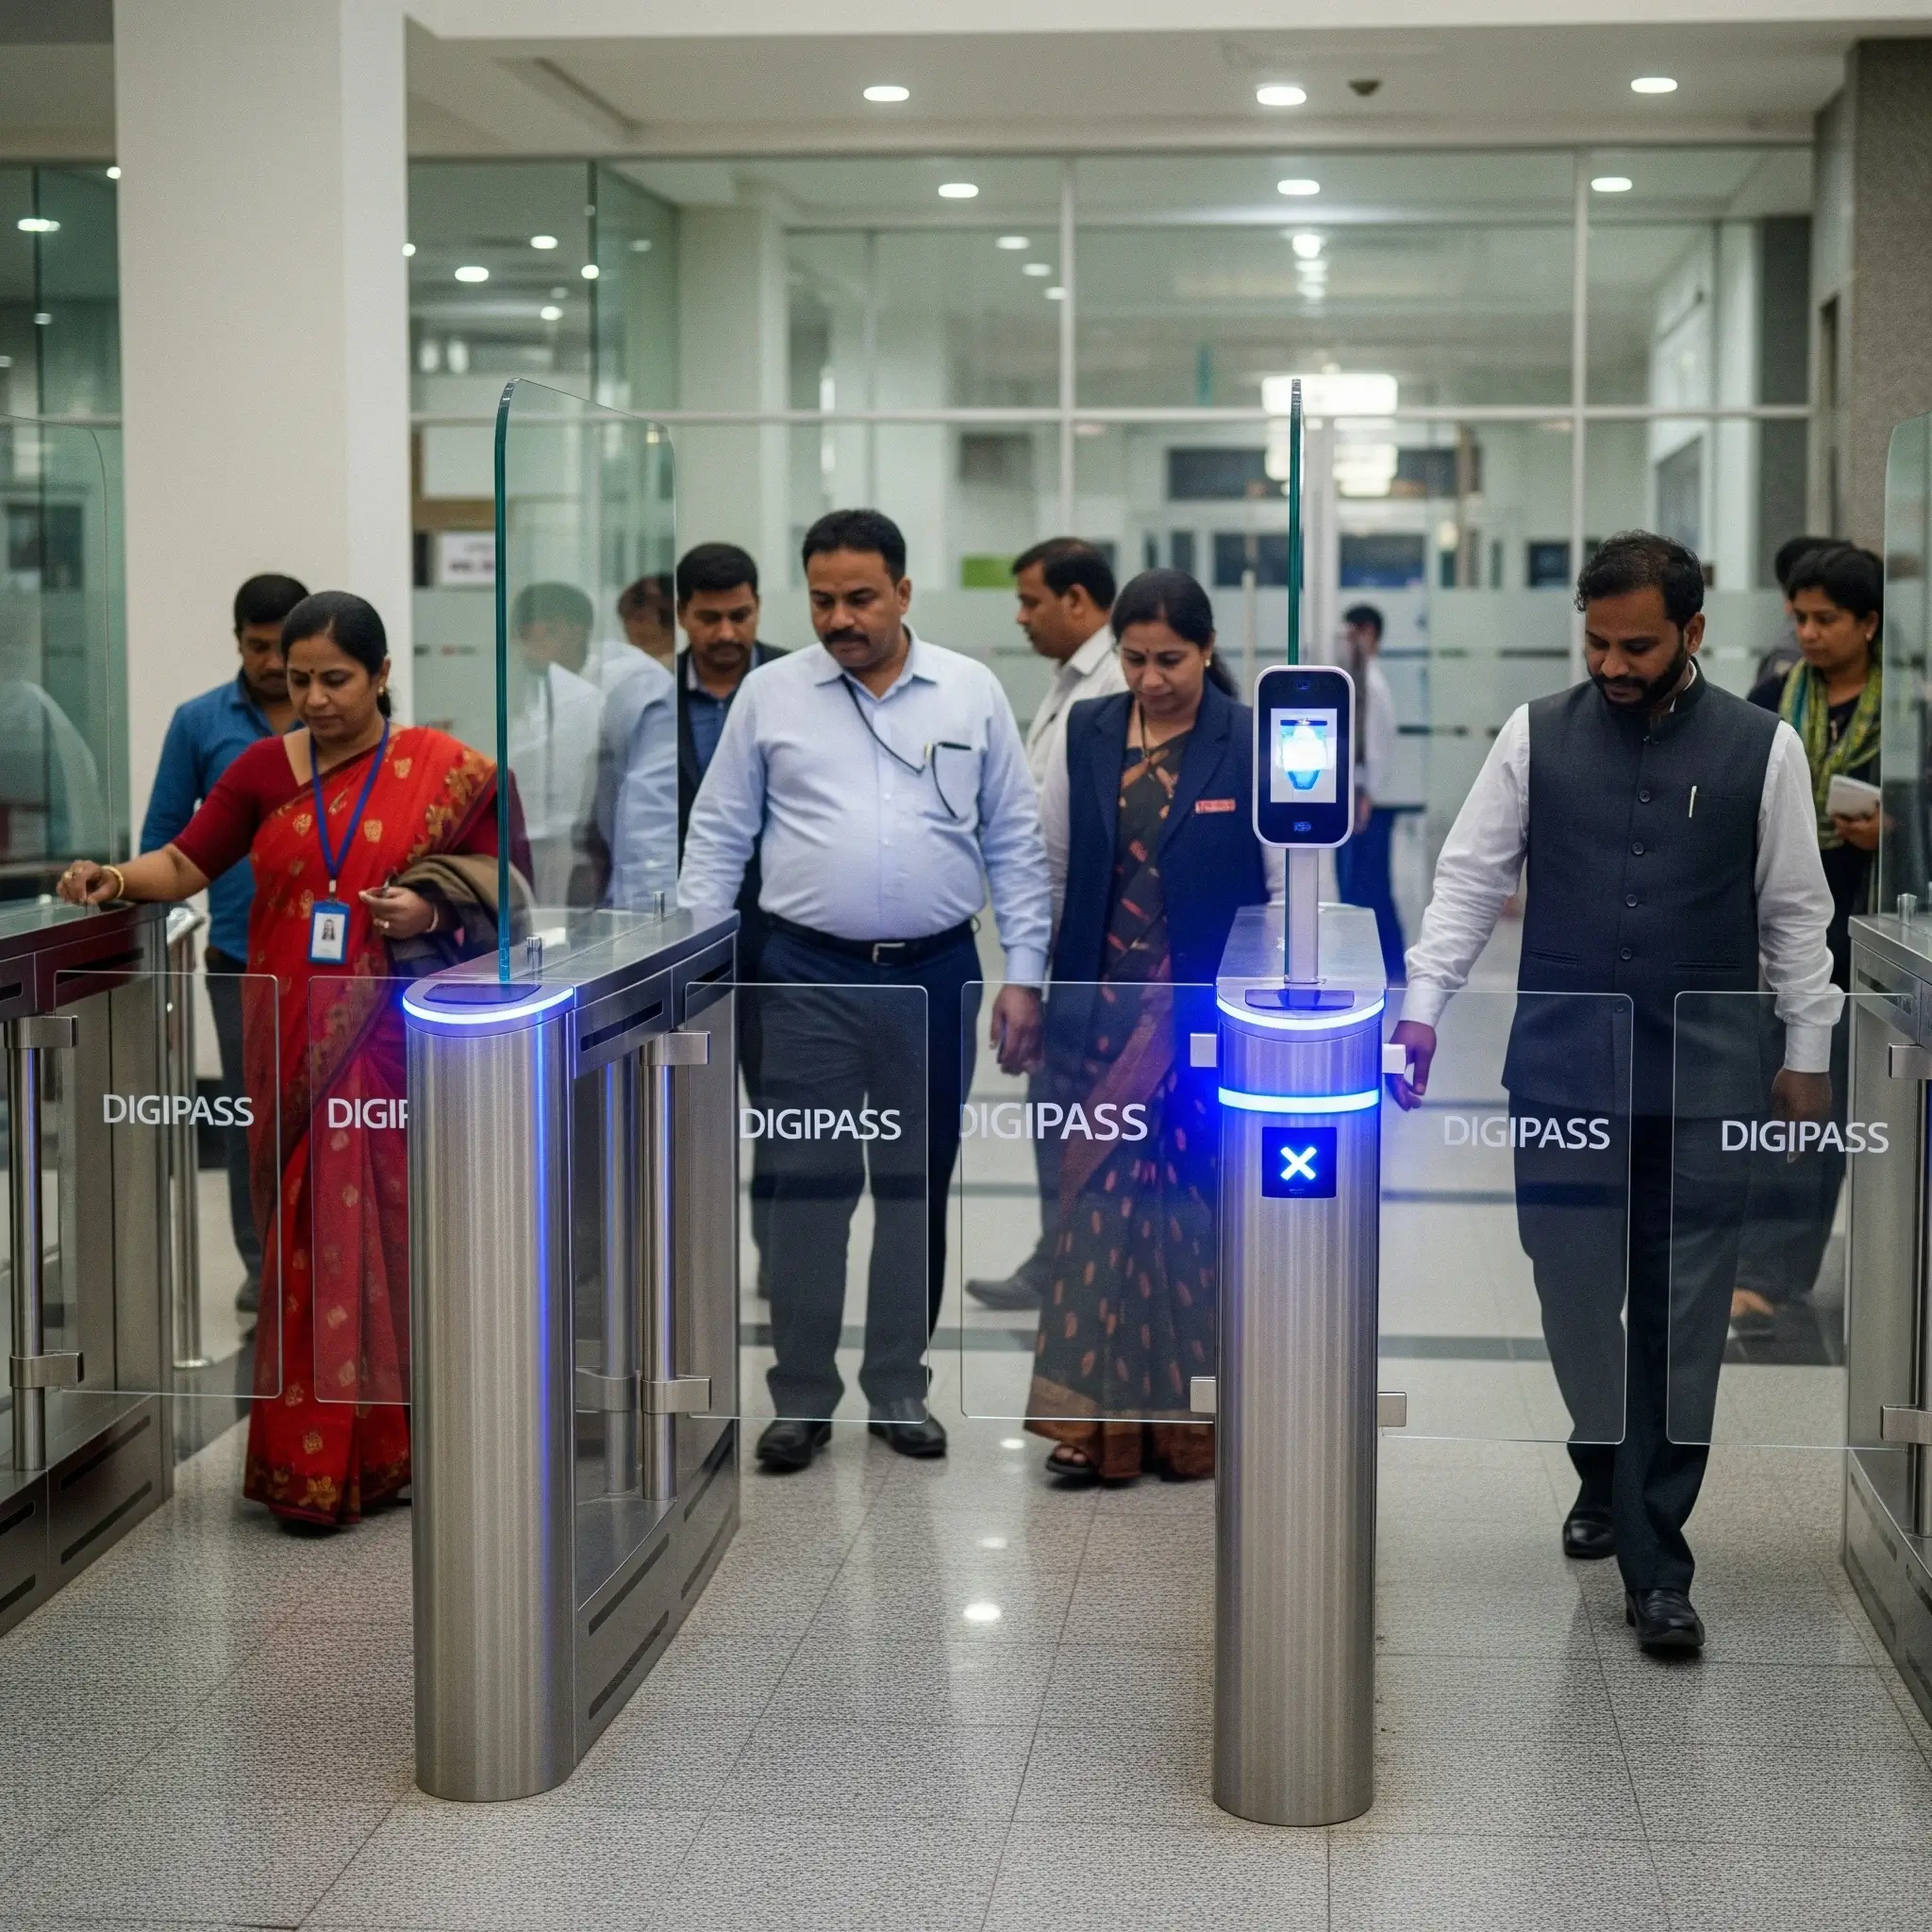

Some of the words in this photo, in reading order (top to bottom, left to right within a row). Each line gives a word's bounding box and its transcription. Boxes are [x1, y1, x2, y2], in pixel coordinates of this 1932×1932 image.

[103, 1093, 254, 1126] DIGIPASS
[740, 1108, 901, 1141] DIGIPASS
[1442, 1116, 1610, 1150] DIGIPASS
[1722, 1120, 1890, 1153] DIGIPASS
